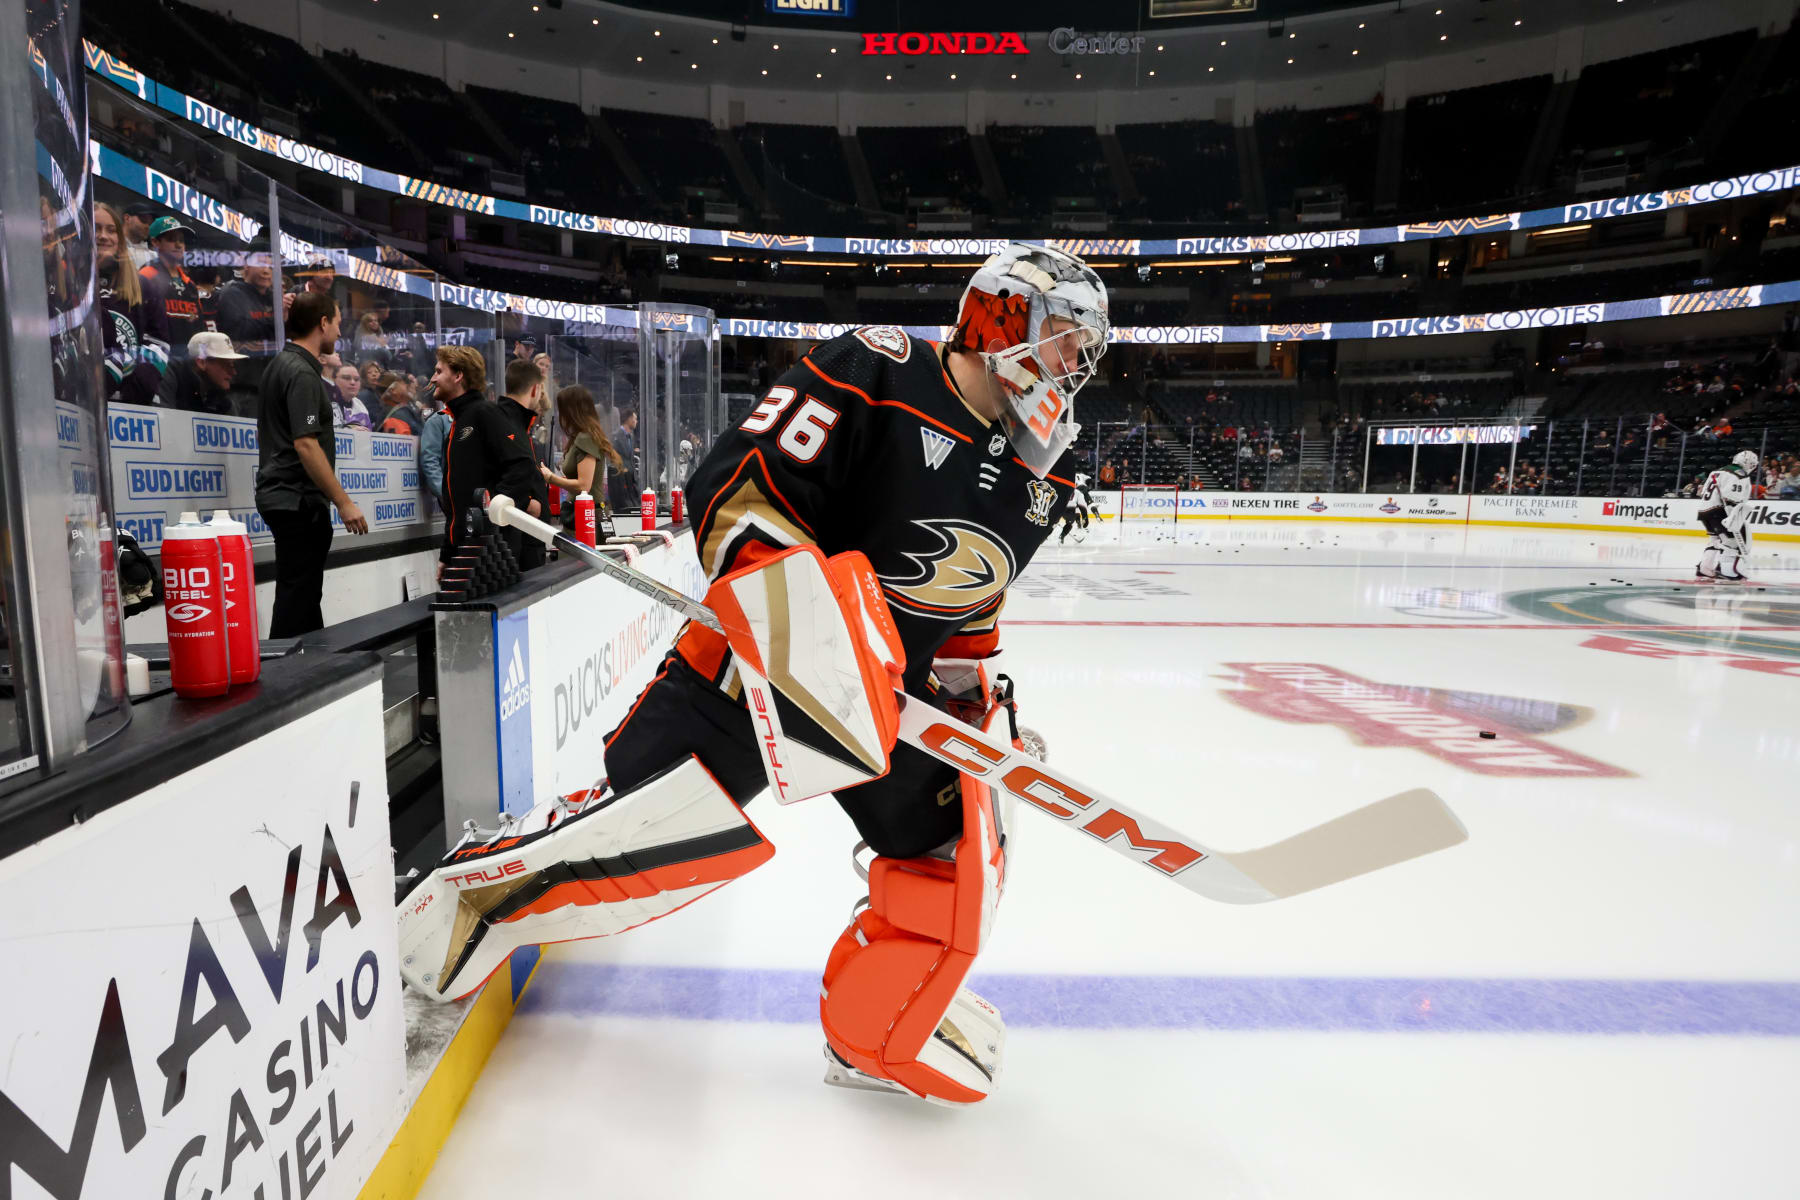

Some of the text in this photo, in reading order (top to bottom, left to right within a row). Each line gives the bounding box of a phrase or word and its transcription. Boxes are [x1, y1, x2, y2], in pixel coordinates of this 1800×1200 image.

[861, 27, 1146, 55] HONDA Center
[190, 100, 258, 146] DUCKS
[278, 138, 361, 183] COYOTES
[151, 172, 224, 227] DUCKS
[1568, 192, 1664, 222] DUCKS
[534, 207, 595, 231] DUCKS
[613, 218, 688, 243] COYOTES
[848, 239, 912, 255] DUCKS
[929, 239, 1007, 256] COYOTES
[1180, 236, 1250, 255] DUCKS
[1268, 231, 1357, 251] COYOTES
[444, 284, 507, 312] DUCKS
[525, 298, 604, 324] COYOTES
[733, 320, 799, 338] DUCKS
[1376, 316, 1461, 338] DUCKS
[1487, 304, 1600, 330] COYOTES
[1134, 326, 1221, 343] COYOTES
[195, 424, 229, 447] BUD
[738, 385, 843, 464] 36
[1398, 427, 1453, 445] DUCKS
[1477, 425, 1516, 444] KINGS
[372, 440, 412, 457] BUD LIGHT
[131, 468, 223, 493] BUD LIGHT
[341, 472, 386, 489] BUD LIGHT
[402, 472, 418, 487] BUD
[375, 502, 415, 520] BUD LIGHT
[1143, 498, 1206, 508] HONDA
[1232, 499, 1271, 509] NEXEN
[1273, 499, 1300, 509] TIRE
[1483, 498, 1579, 509] PACIFIC PREMIER
[1515, 508, 1545, 517] BANK
[1615, 499, 1669, 520] impact
[1745, 505, 1800, 527] ikse
[163, 567, 211, 589] BIO
[603, 564, 688, 613] CCM
[166, 590, 211, 600] STEEL
[500, 684, 531, 722] adidas
[1249, 663, 1594, 772] ARROWHEAD
[750, 687, 789, 801] TRUE
[917, 722, 1209, 877] CCM
[445, 859, 527, 888] TRUE
[163, 949, 380, 1200] CASINO
